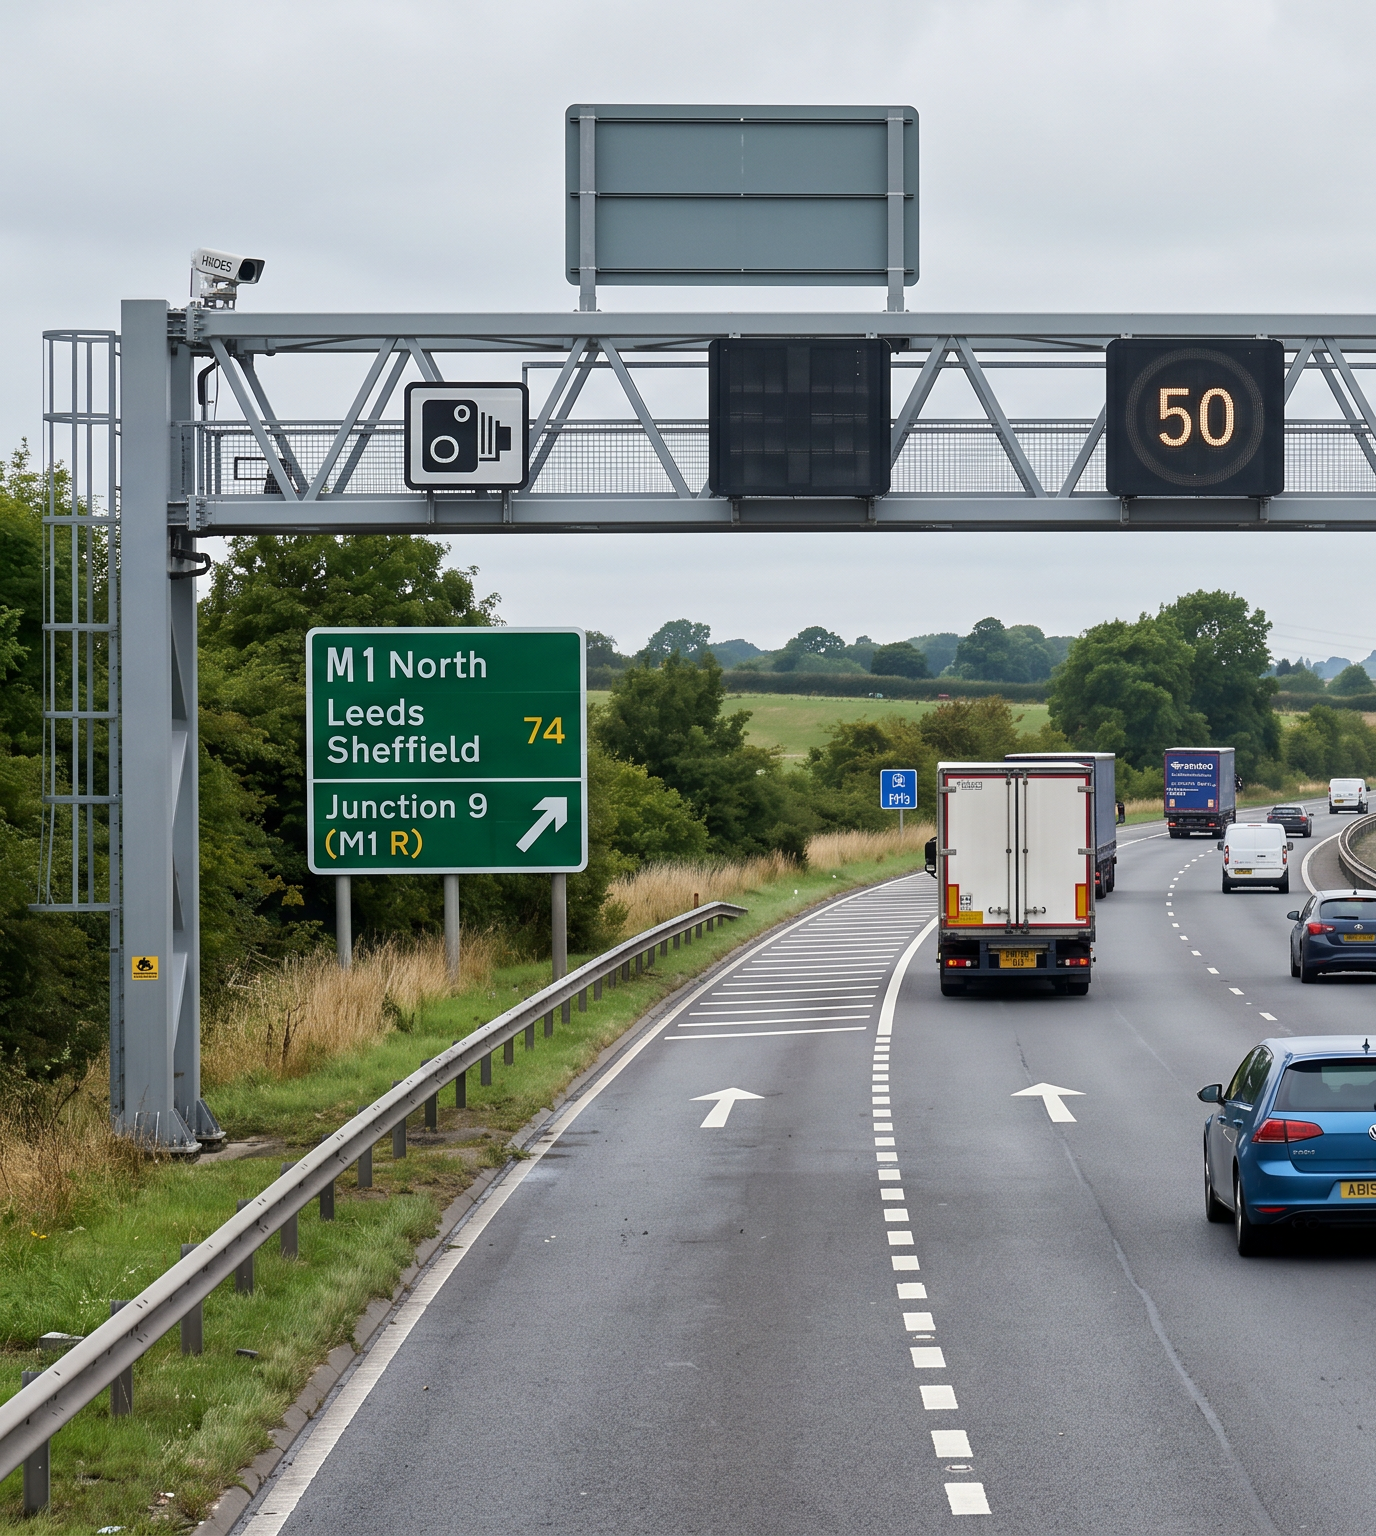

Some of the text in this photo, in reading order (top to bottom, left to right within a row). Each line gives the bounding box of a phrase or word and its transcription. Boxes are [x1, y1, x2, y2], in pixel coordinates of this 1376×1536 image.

[1158, 387, 1235, 447] 50
[389, 650, 487, 679] North
[328, 698, 424, 727] Leeds
[523, 716, 566, 745] 74
[327, 735, 480, 764] Sheffield
[325, 792, 488, 820] Junction 9
[325, 828, 423, 860] (M1 R)
